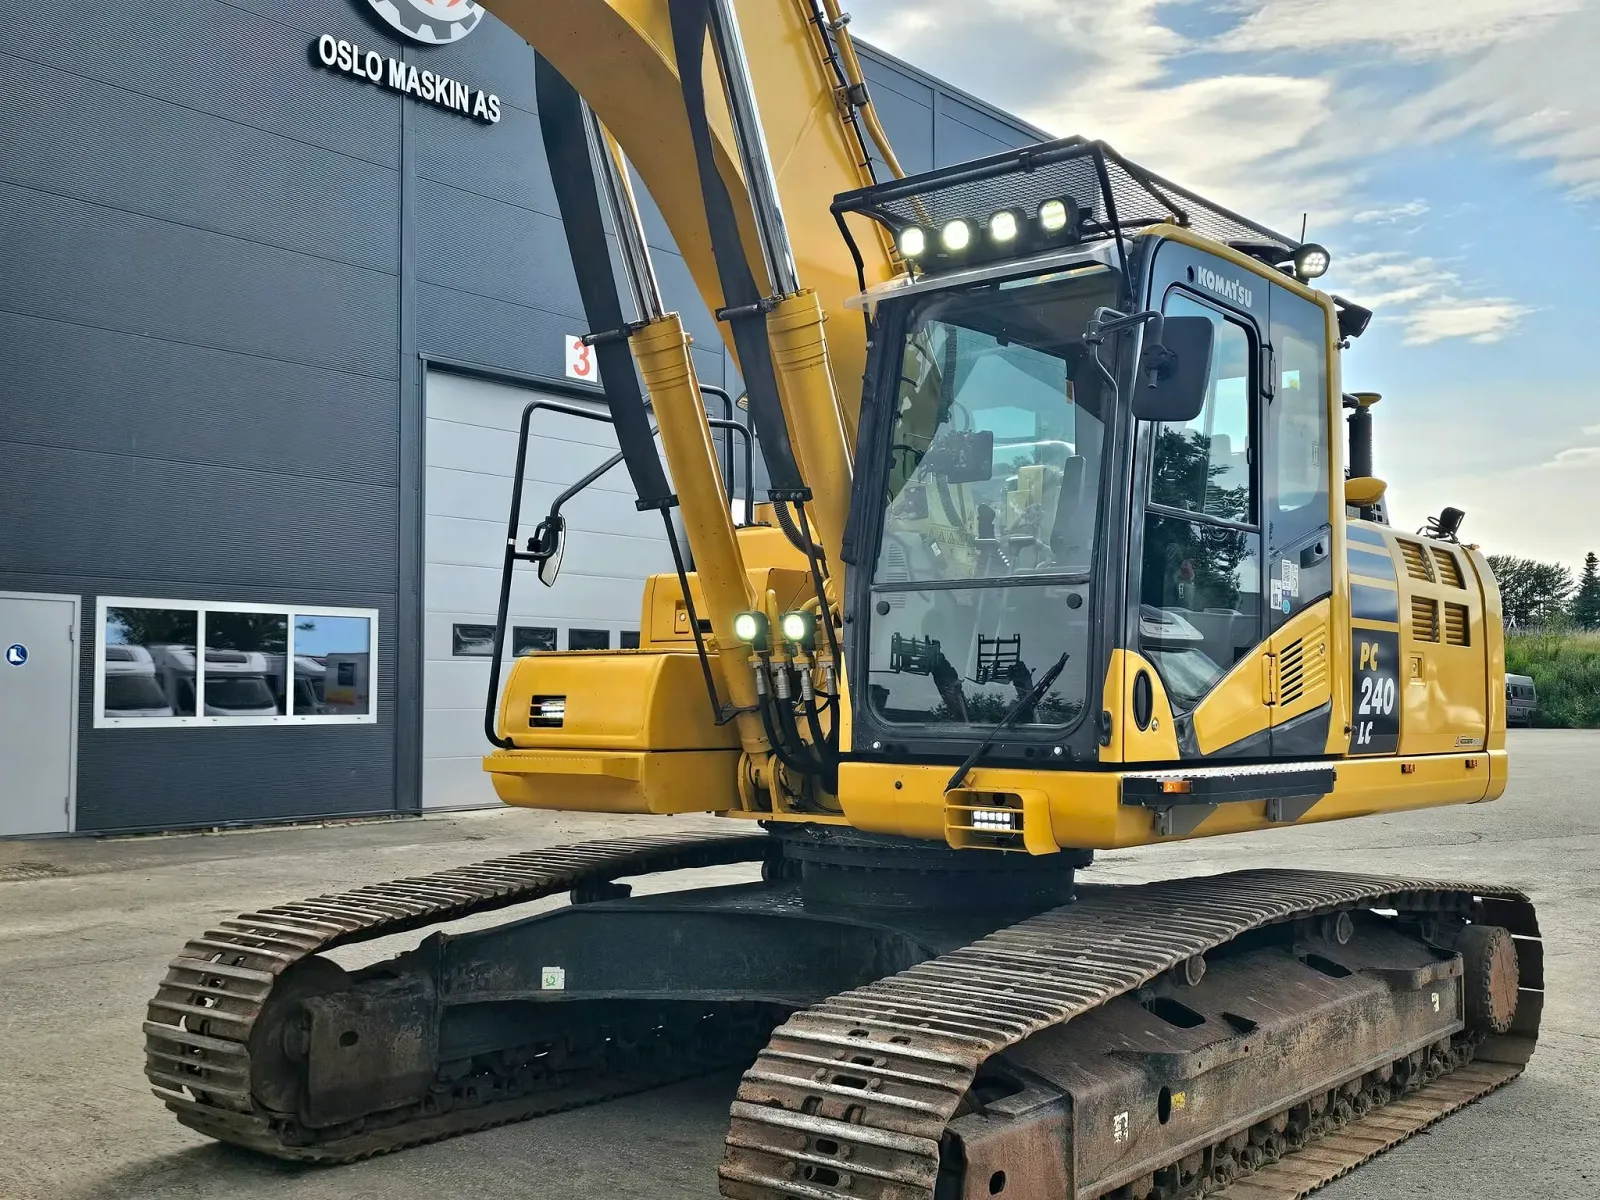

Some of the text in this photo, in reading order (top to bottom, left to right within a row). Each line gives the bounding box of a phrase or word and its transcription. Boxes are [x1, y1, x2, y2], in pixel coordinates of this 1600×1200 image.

[319, 34, 501, 123] OSLO MASKIN AS
[1197, 266, 1252, 308] KOMATSU
[573, 340, 590, 376] 3
[1360, 642, 1379, 672] PC
[1358, 677, 1395, 715] 240
[1357, 721, 1373, 745] LC
